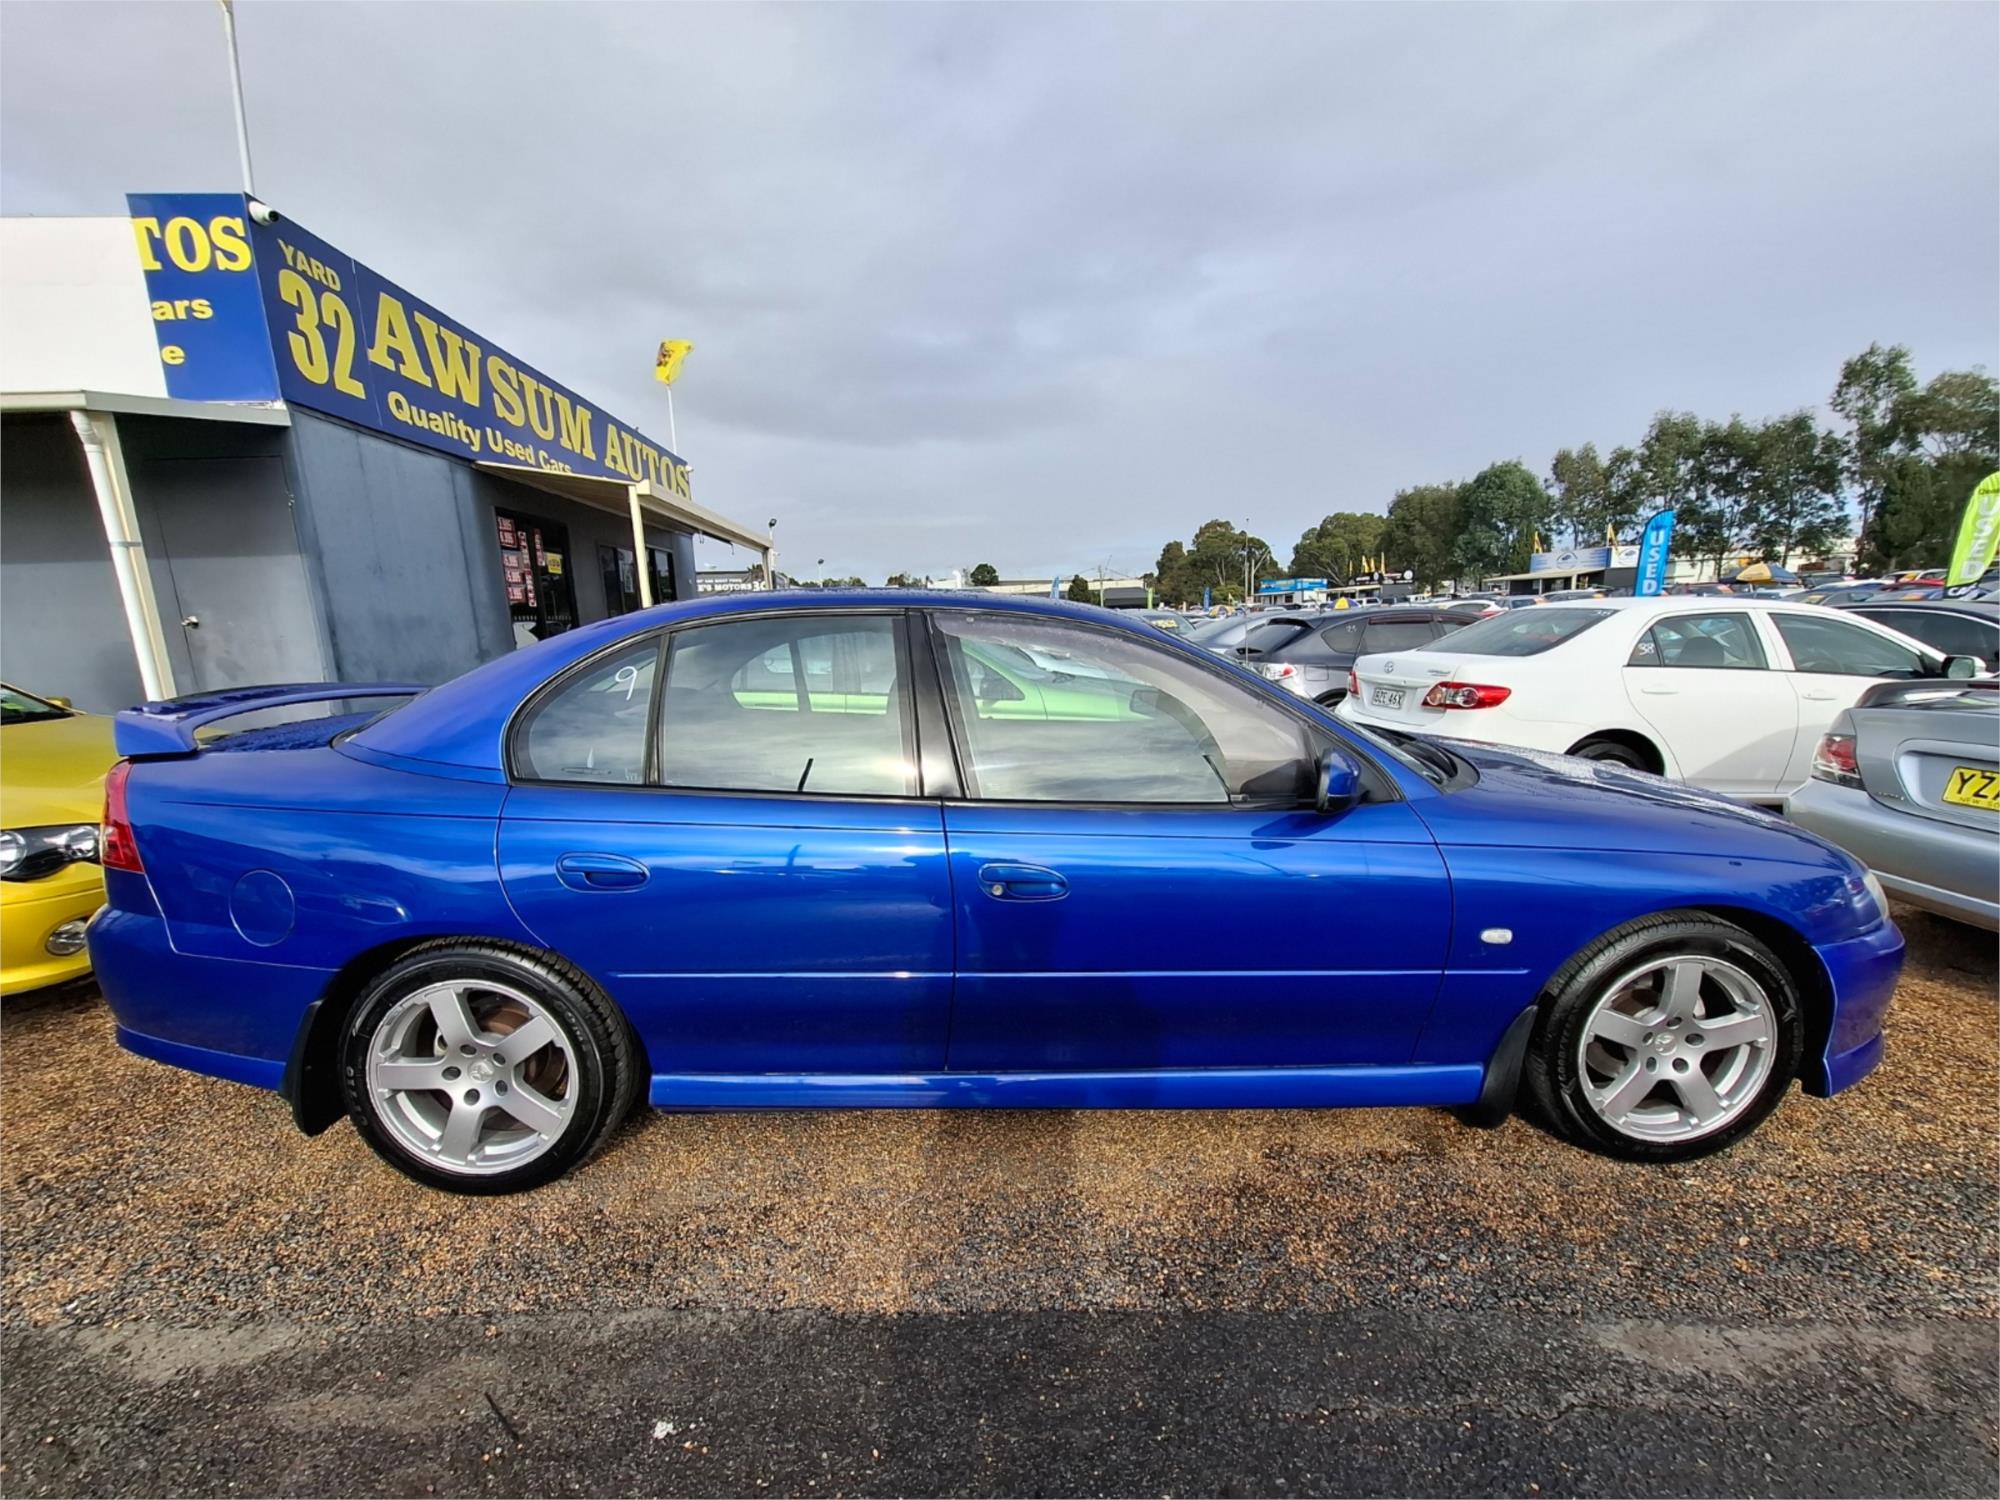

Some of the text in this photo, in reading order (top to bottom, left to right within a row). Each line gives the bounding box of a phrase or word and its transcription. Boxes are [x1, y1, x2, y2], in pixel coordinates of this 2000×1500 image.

[277, 237, 341, 291] YARD
[278, 268, 366, 400] 32
[388, 391, 572, 473] Quality Used Cars
[605, 423, 691, 500] AUTOS
[1641, 529, 1668, 594] USED
[1961, 495, 2000, 580] USED
[714, 583, 752, 592] MOTORS
[615, 665, 638, 701] 9
[1956, 771, 2000, 801] YZ
